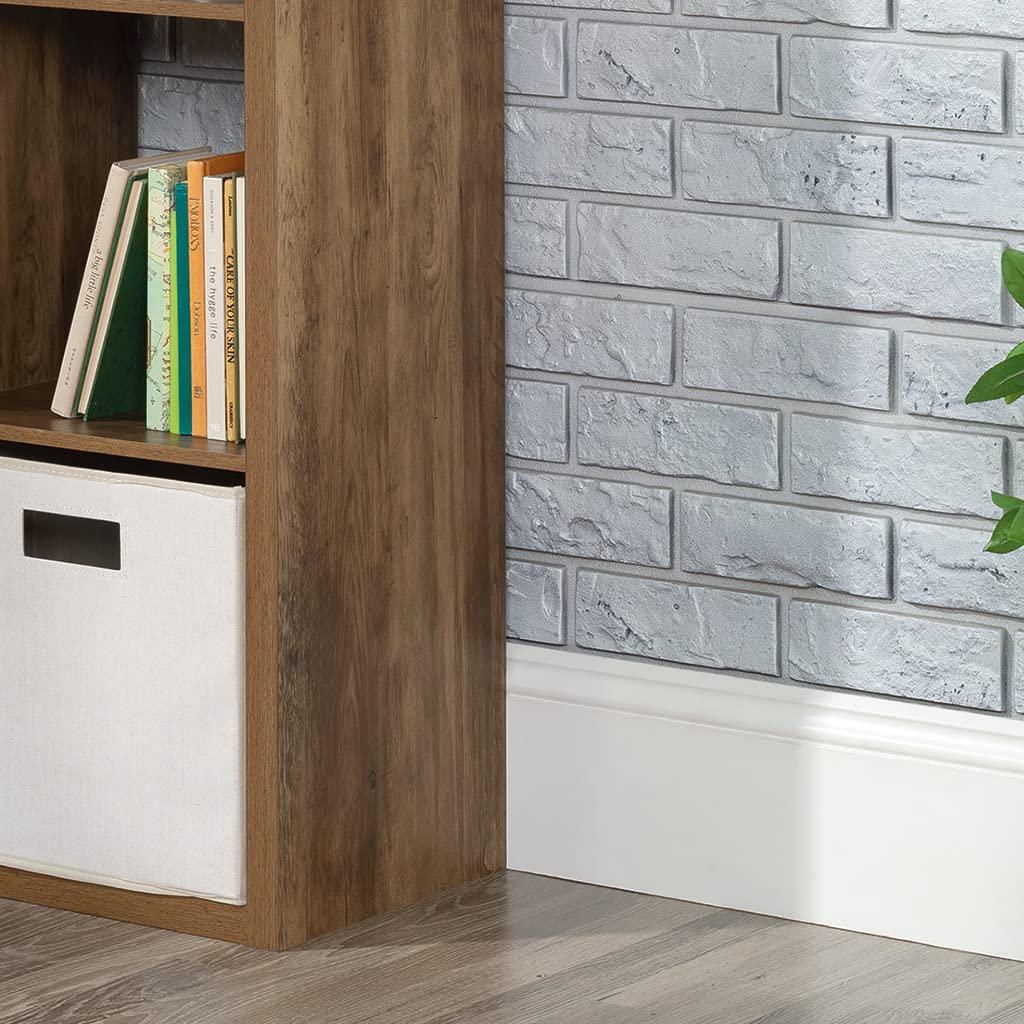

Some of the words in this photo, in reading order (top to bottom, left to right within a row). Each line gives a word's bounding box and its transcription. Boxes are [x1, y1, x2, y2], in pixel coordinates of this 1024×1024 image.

[189, 197, 201, 252] EMOTIONS
[91, 255, 104, 272] big
[208, 266, 217, 284] the
[226, 255, 235, 284] CARE
[86, 273, 100, 293] little
[226, 286, 235, 300] OF
[83, 294, 95, 310] life
[207, 288, 217, 318] hygge
[193, 301, 201, 336] Dobson
[226, 304, 235, 334] YOUR
[210, 322, 218, 340] life
[226, 336, 235, 364] SKIN
